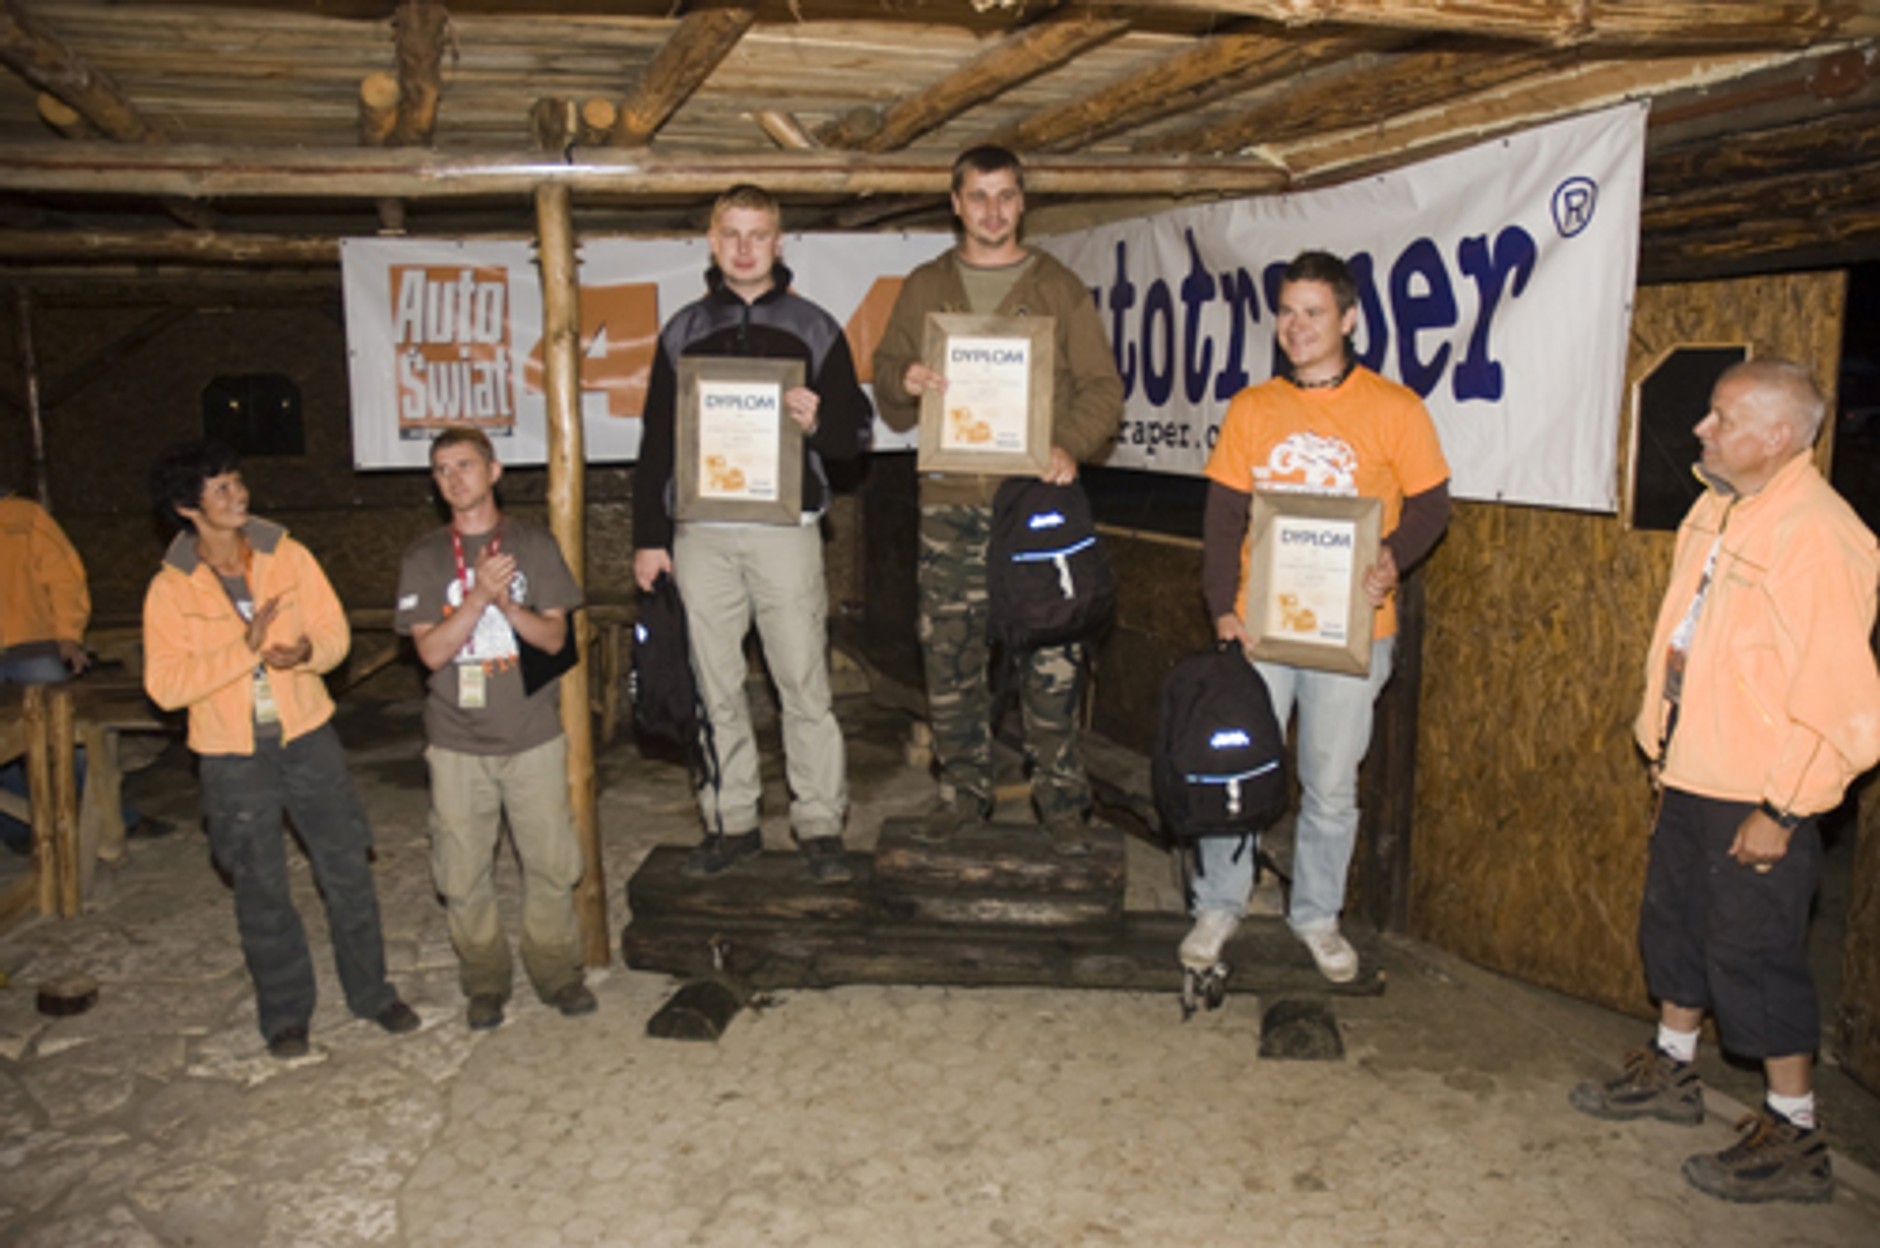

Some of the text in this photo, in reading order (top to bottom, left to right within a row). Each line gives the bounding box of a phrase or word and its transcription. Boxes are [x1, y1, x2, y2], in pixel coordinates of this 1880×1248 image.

[393, 269, 505, 343] Auto
[951, 348, 1024, 366] DYPLOM
[401, 345, 512, 420] Świat
[704, 394, 776, 411] DYPLOM
[1281, 528, 1351, 549] DYPLOM
